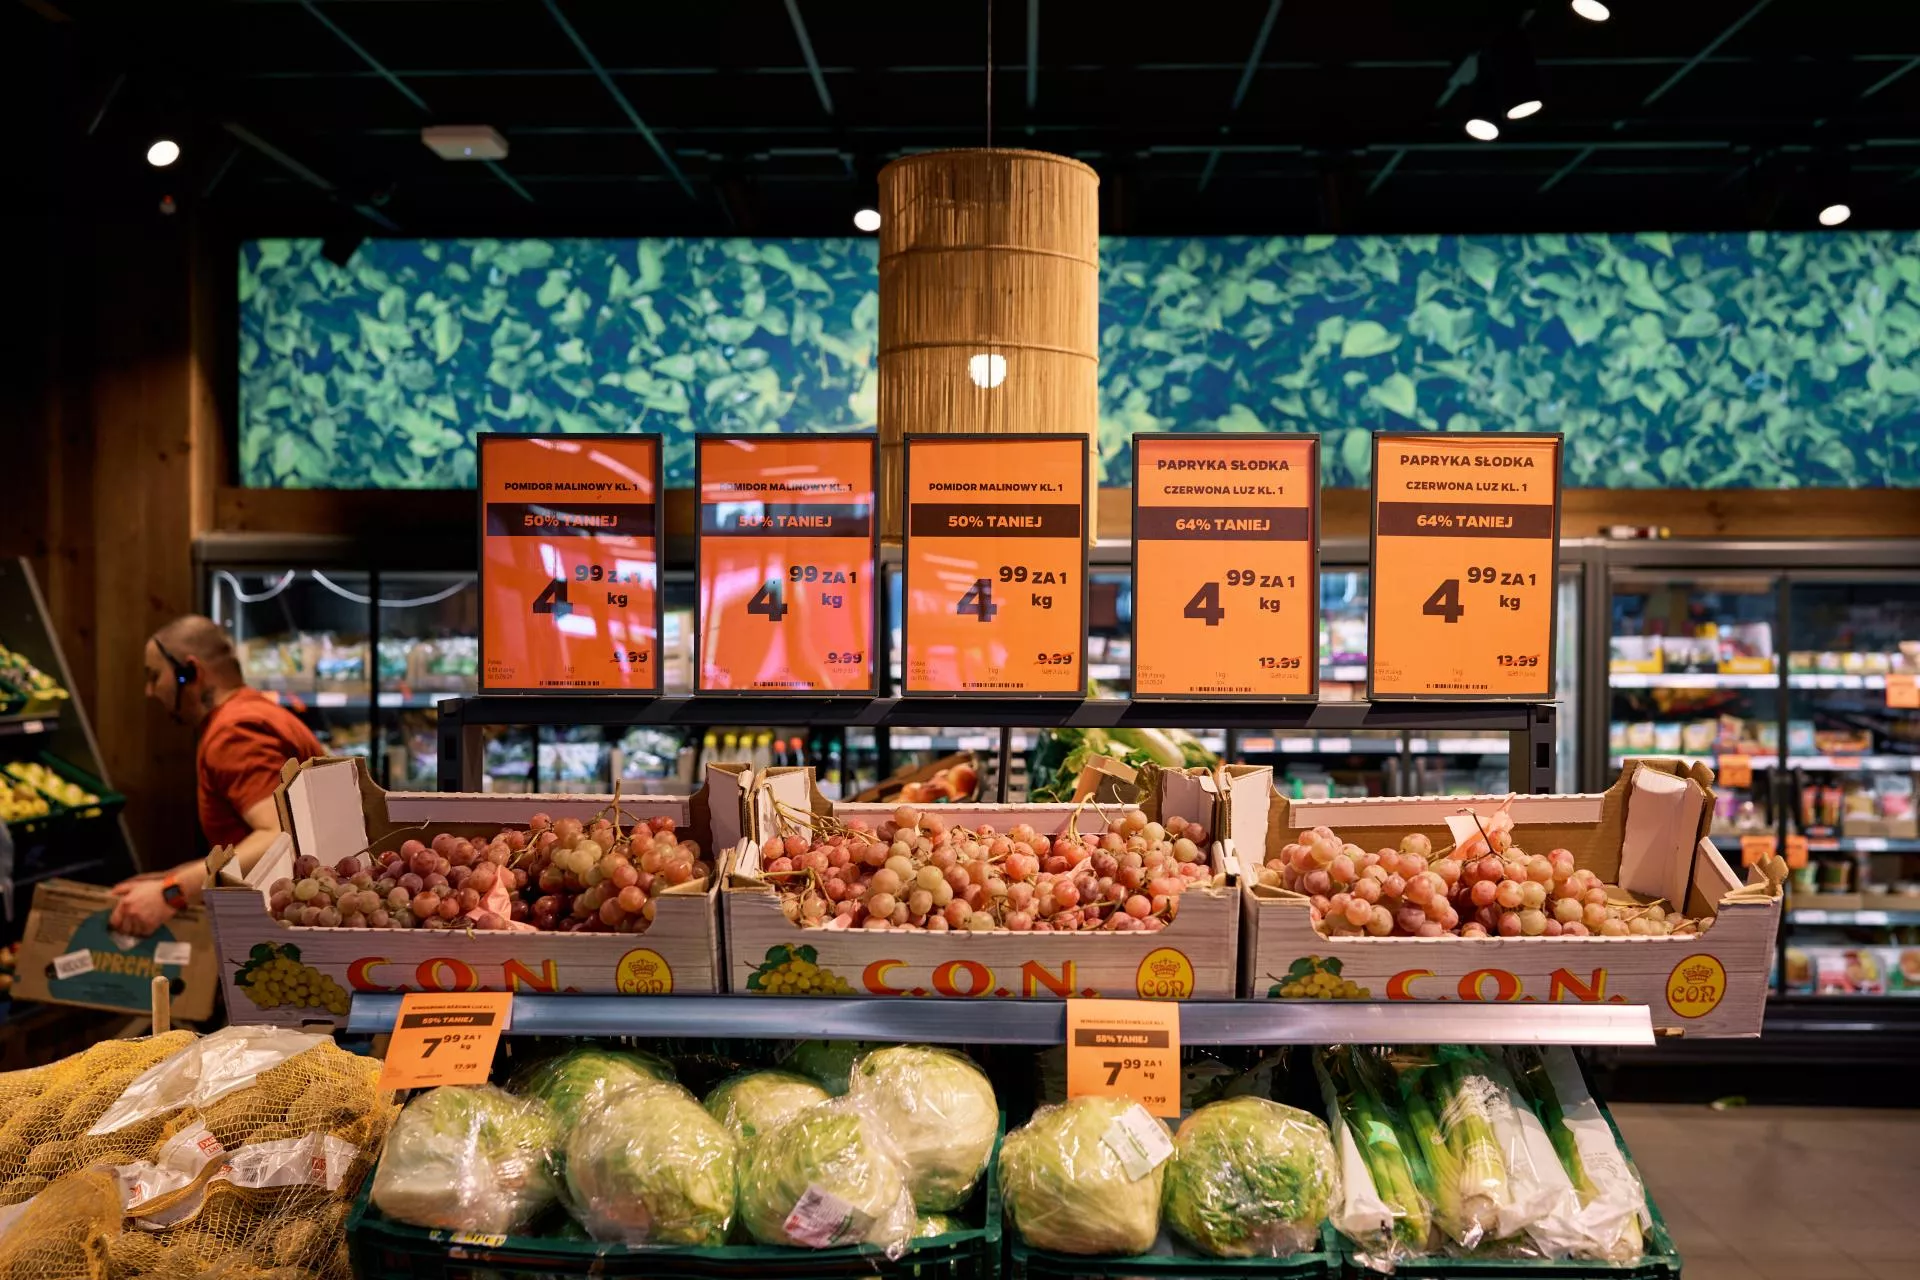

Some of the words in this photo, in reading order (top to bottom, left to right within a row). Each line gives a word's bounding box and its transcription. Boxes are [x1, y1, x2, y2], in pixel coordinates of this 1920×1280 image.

[1158, 460, 1227, 471] PAPRYKA
[1231, 460, 1289, 471] SŁODKA
[1400, 454, 1471, 466] PAPRYKA
[1474, 456, 1534, 468] SŁODKA
[504, 482, 552, 492] POMIDOR
[555, 482, 612, 492] MALINOWY
[615, 482, 631, 492] KL.
[632, 482, 638, 492] 1
[720, 483, 767, 492] POMIDOR
[770, 483, 827, 492] MALINOWY
[829, 483, 846, 492] KL.
[848, 483, 853, 492] 1
[929, 483, 977, 492] POMIDOR
[980, 483, 1038, 492] MALINOWY
[1040, 483, 1056, 492] KL.
[1058, 483, 1063, 492] 1
[1164, 486, 1230, 495] CZERWONA
[1233, 486, 1255, 495] LUZ
[1258, 486, 1276, 495] KL.
[1278, 486, 1284, 495] 1
[1406, 481, 1473, 491] CZERWONA
[1476, 483, 1498, 492] LUZ
[1501, 483, 1519, 492] KL.
[1522, 483, 1527, 492] 1
[524, 515, 560, 527] 50%
[564, 515, 618, 527] TANIEJ
[739, 515, 773, 527] 50%
[777, 516, 832, 528] TANIEJ
[949, 516, 983, 527] 50%
[987, 516, 1042, 528] TANIEJ
[1176, 519, 1211, 531] 64%
[1214, 519, 1270, 531] TANIEJ
[1416, 515, 1452, 527] 64%
[1456, 516, 1513, 528] TANIEJ
[575, 565, 603, 581] 99
[790, 566, 818, 582] 99
[822, 572, 846, 584] ZA
[849, 572, 856, 584] 1
[999, 566, 1028, 583] 99
[1032, 572, 1056, 584] ZA
[1059, 572, 1066, 584] 1
[1226, 570, 1255, 586] 99
[1260, 575, 1283, 588] ZA
[1287, 576, 1295, 588] 1
[1467, 567, 1496, 583] 99
[1500, 573, 1524, 586] ZA
[1528, 573, 1536, 586] 1
[533, 578, 573, 621] 4
[608, 592, 628, 607] kg
[747, 578, 788, 622] 4
[821, 593, 842, 609] kg
[957, 578, 997, 622] 4
[1032, 594, 1052, 609] kg
[1184, 582, 1224, 626] 4
[1260, 597, 1280, 613] kg
[1423, 579, 1464, 623] 4
[1500, 595, 1520, 610] kg
[613, 651, 648, 662] 999
[1038, 653, 1072, 664] 9.99
[1259, 657, 1300, 669] 13.99
[1497, 655, 1538, 667] 13.99
[91, 949, 164, 978] UPREME
[862, 958, 1100, 998] C.O.N.
[443, 1034, 461, 1043] 99
[1116, 1035, 1149, 1043] TANIEJ
[421, 1037, 442, 1058] 7
[1123, 1059, 1141, 1069] 99
[1103, 1061, 1122, 1086] 7
